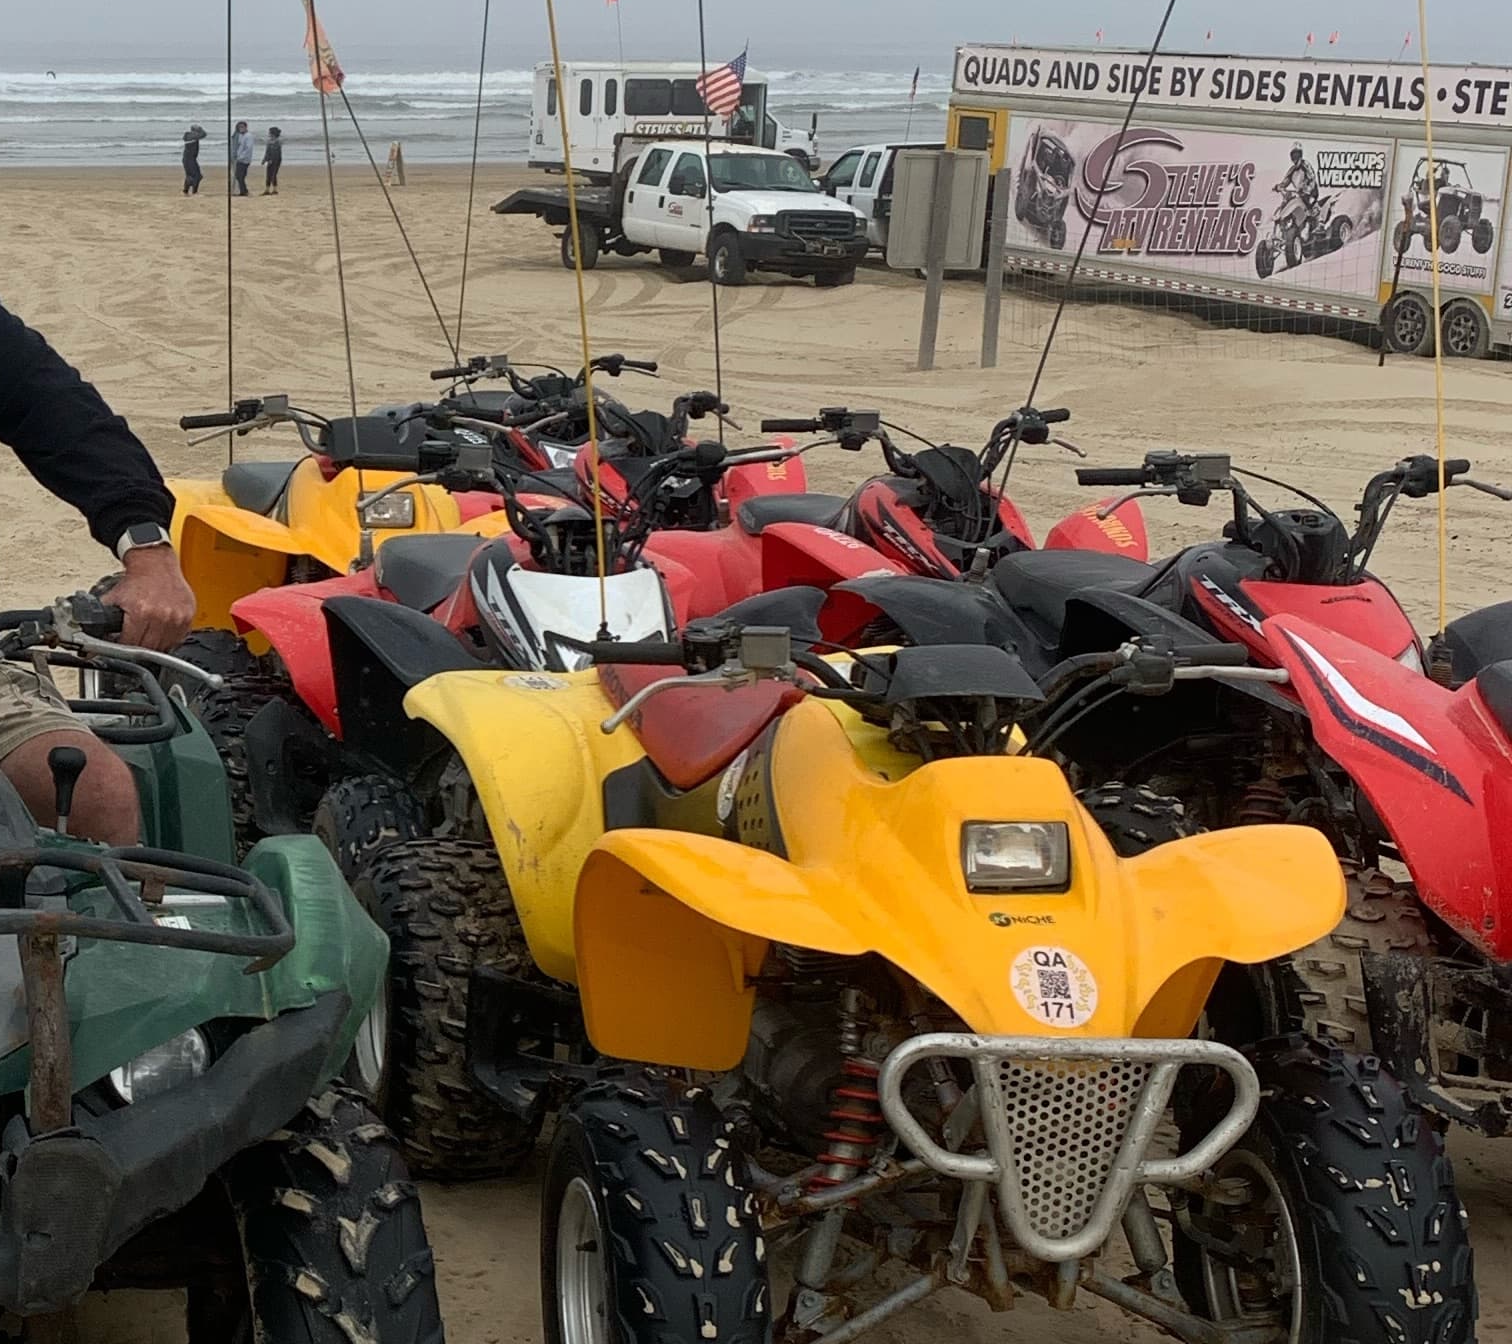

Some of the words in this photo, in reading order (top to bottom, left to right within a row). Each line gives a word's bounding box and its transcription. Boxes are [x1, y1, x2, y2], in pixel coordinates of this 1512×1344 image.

[964, 56, 1041, 87] QUADS
[1046, 61, 1100, 91] AND
[1107, 64, 1163, 95] SIDE
[1170, 67, 1205, 98] BY
[1209, 68, 1287, 103] SIDES
[1295, 72, 1425, 111] RENTALS
[1452, 79, 1511, 116] STE
[1317, 151, 1385, 169] WALK-UPS
[1317, 169, 1383, 188] WELCOME
[1098, 207, 1154, 253] ATV
[1148, 207, 1263, 254] RENTALS
[1200, 573, 1265, 637] TRX
[1011, 915, 1056, 924] NICHE
[1033, 951, 1067, 968] QA
[1040, 1001, 1075, 1019] 171
